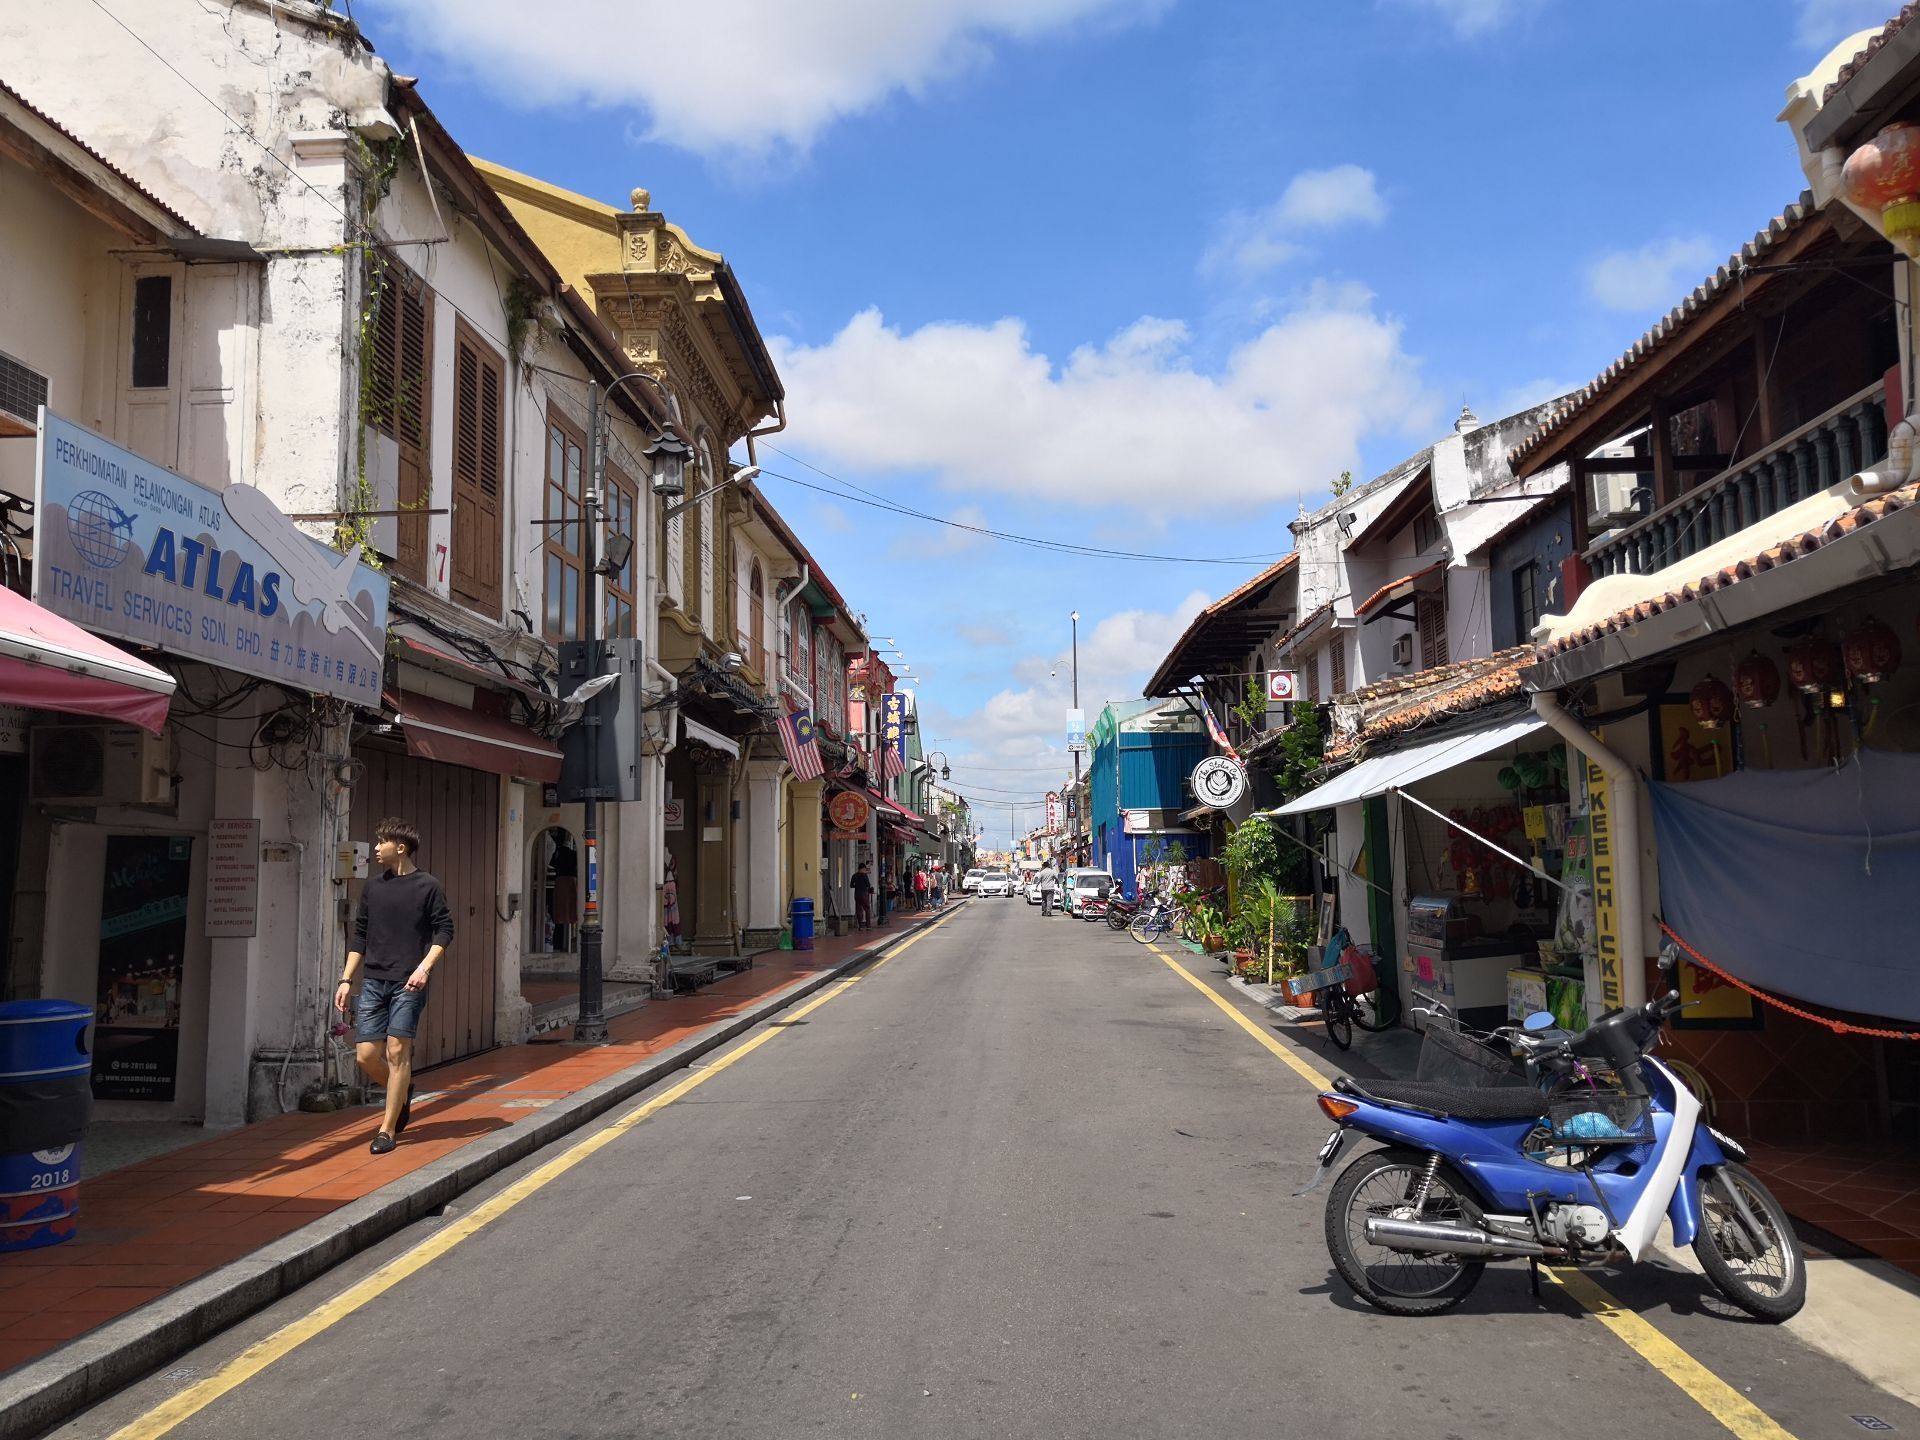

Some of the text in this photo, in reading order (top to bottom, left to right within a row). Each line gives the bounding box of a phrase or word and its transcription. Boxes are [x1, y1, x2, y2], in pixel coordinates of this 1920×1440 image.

[56, 438, 221, 531] PERKHIDMATAN PELANCONGAN ATLAS
[143, 526, 280, 618] ATLAS
[50, 566, 263, 658] TRAVEL SERVICES SDN. BHD.
[1198, 769, 1209, 780] The
[1209, 760, 1229, 770] Stolen
[1590, 791, 1609, 856] KEE
[30, 1169, 70, 1189] 2018
